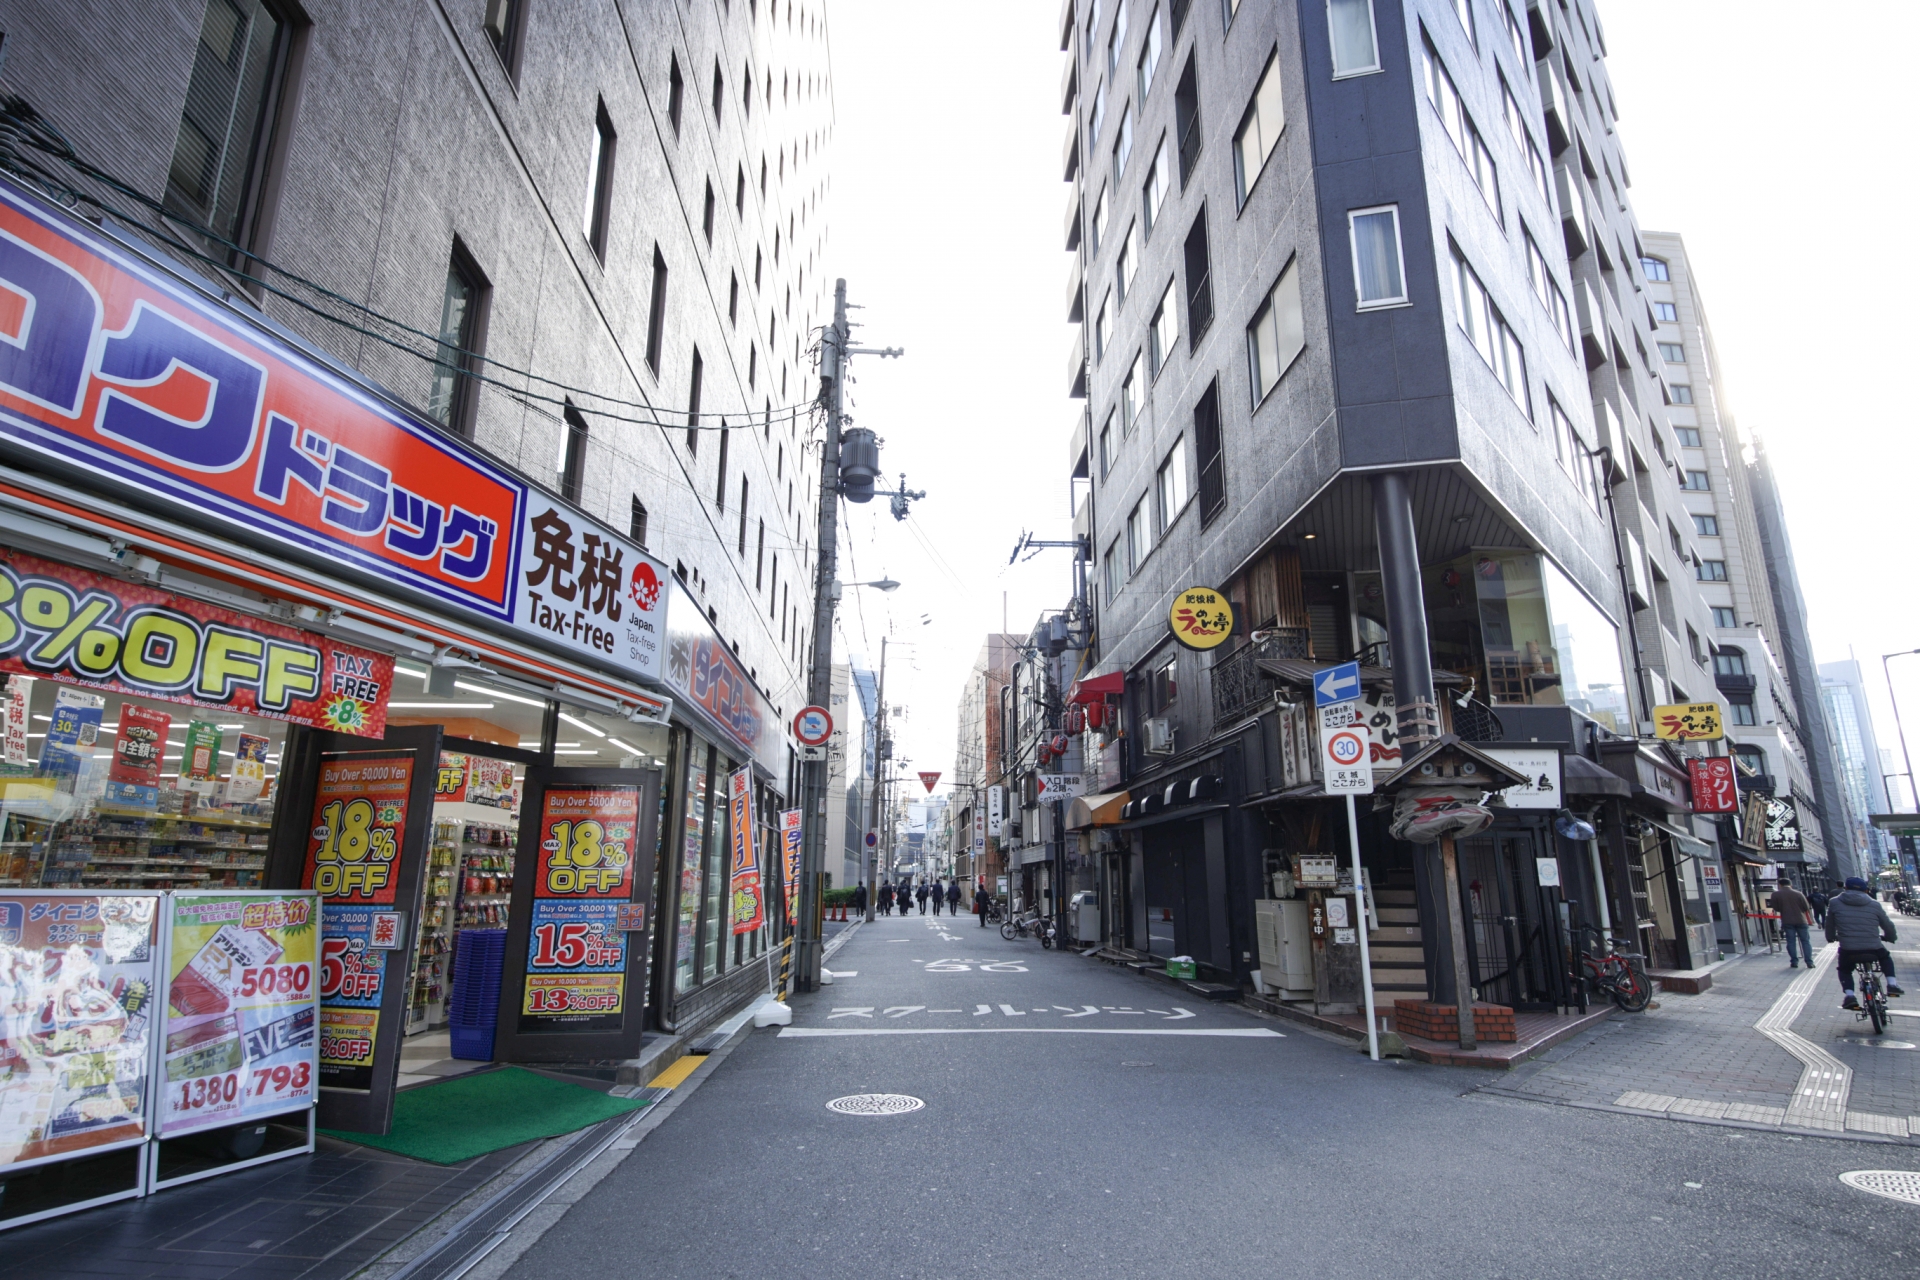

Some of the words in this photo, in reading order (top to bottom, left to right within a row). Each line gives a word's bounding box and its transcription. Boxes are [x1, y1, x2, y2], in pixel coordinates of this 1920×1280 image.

[526, 507, 623, 622] 免税
[1185, 594, 1216, 604] 肥後橋
[529, 590, 615, 654] Tax-Free
[629, 612, 656, 634] Japan.
[626, 628, 656, 652] Tax-free
[331, 651, 373, 679] TAX
[629, 647, 650, 666] Shop
[53, 672, 77, 684] Some
[79, 676, 117, 693] products
[119, 686, 133, 695] are
[135, 688, 149, 698] not
[152, 691, 169, 702] able
[181, 695, 193, 706] be
[331, 672, 380, 704] FREE
[328, 699, 363, 728] +8%
[1324, 704, 1353, 717] 自転車を除く
[1325, 713, 1354, 728] ここから
[7, 725, 24, 740] Tax
[5, 736, 26, 752] Free
[1336, 740, 1356, 756] 30
[325, 769, 340, 783] Buy
[341, 768, 361, 781] Over
[362, 767, 389, 782] 50,000
[391, 766, 406, 779] Yen
[735, 773, 746, 795] 薬
[1046, 776, 1061, 785] 入口
[1332, 779, 1366, 788] ここから
[376, 800, 405, 808] TAX-FREE
[550, 796, 565, 808] Buy
[567, 796, 587, 807] Over
[588, 796, 615, 808] 50,000
[617, 797, 632, 807] Yen
[314, 829, 330, 837] MAX
[315, 799, 396, 864] 18%
[735, 799, 746, 867] ダイコク
[1764, 827, 1798, 841] 豚骨
[548, 820, 628, 869] 18%
[1767, 840, 1800, 848] らーめん
[313, 862, 389, 896] OFF
[548, 868, 622, 893] OFF
[242, 898, 310, 930] 超特价
[341, 913, 368, 923] 30,000
[540, 904, 556, 913] Buy
[557, 904, 577, 912] Over
[578, 904, 606, 913] 30,000
[48, 924, 77, 933] 今すぐ
[375, 915, 396, 945] 薬
[1312, 907, 1323, 935] 支度中
[214, 933, 252, 967] アリナミン
[350, 941, 365, 949] MAX
[532, 922, 605, 967] 15%
[585, 948, 621, 966] OFF
[341, 973, 380, 997] OFF
[558, 977, 577, 985] 10,000
[244, 1019, 290, 1063] EVE
[335, 1027, 359, 1036] TAX-FREE
